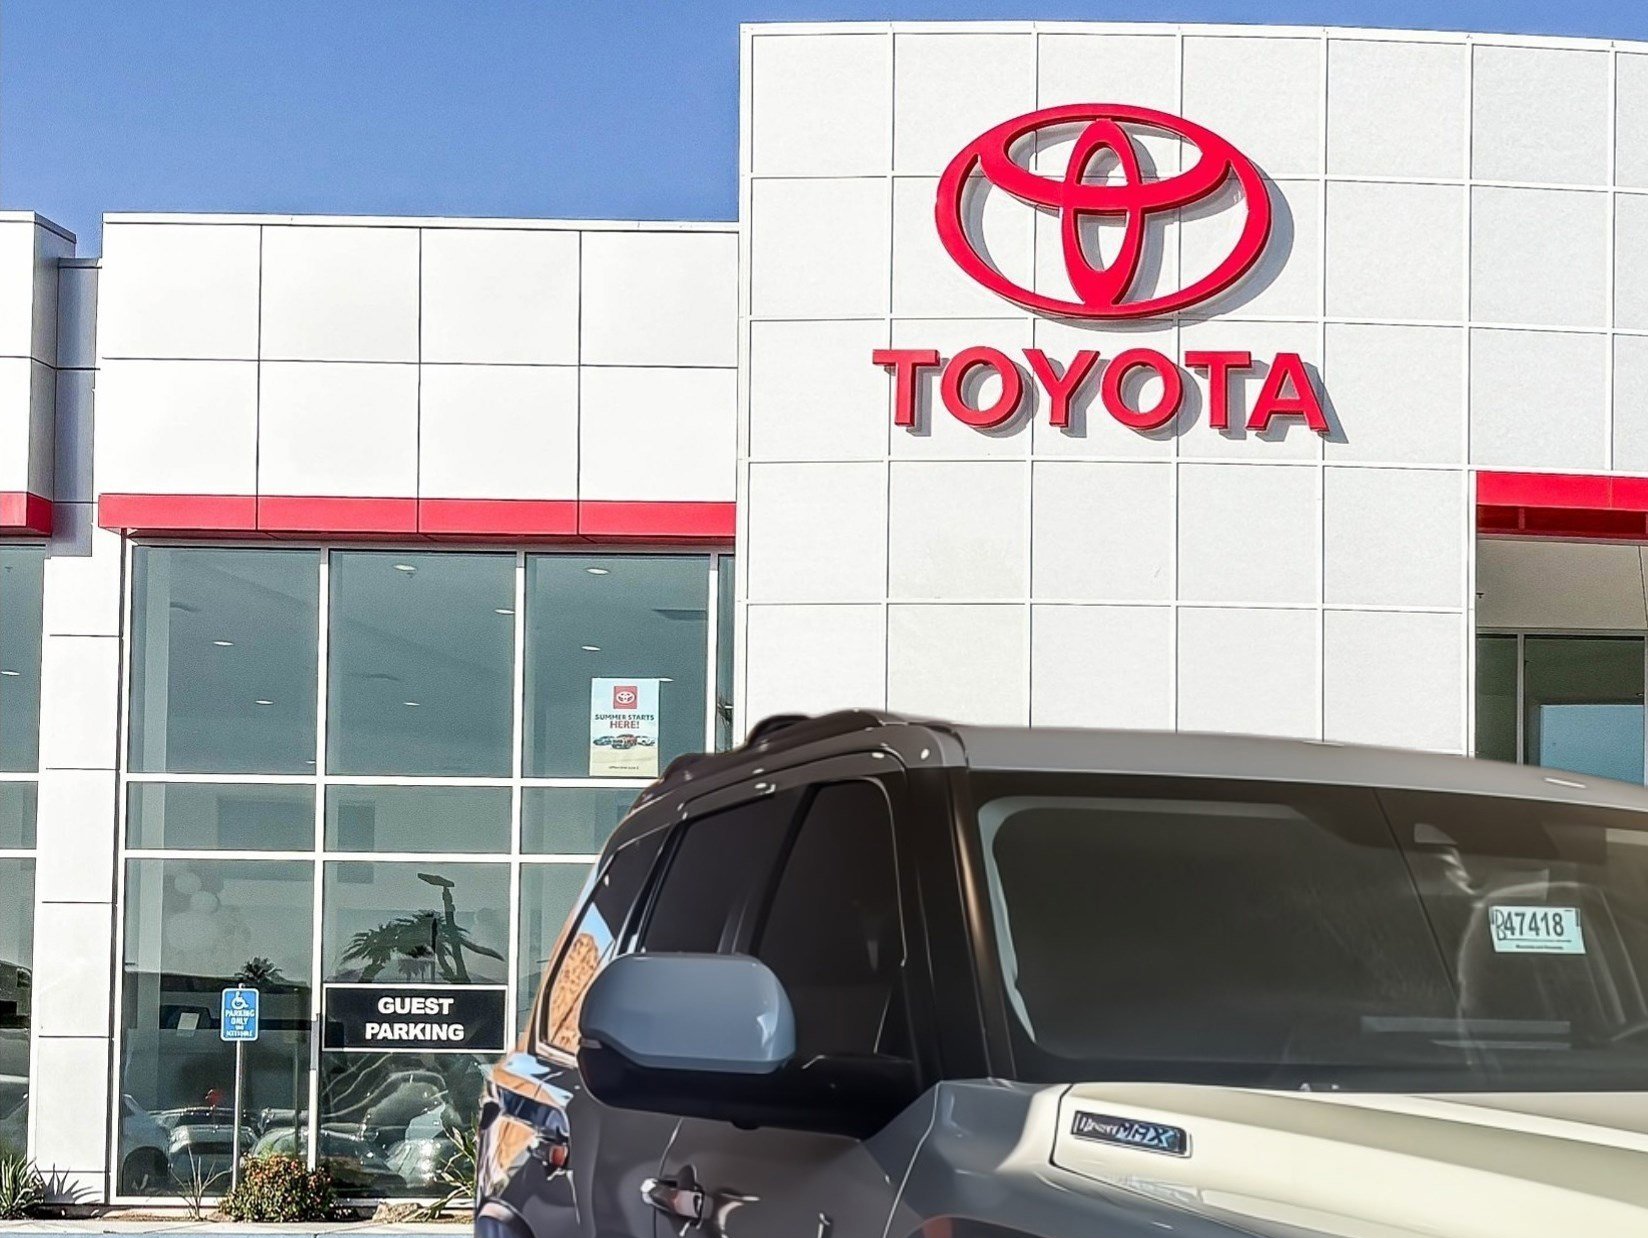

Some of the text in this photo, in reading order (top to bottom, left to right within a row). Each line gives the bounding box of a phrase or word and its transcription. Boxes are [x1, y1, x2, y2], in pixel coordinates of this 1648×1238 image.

[873, 346, 1330, 432] TOYOTA
[609, 720, 640, 729] HERE!
[377, 997, 455, 1015] GUEST
[365, 1022, 465, 1041] PARKING
